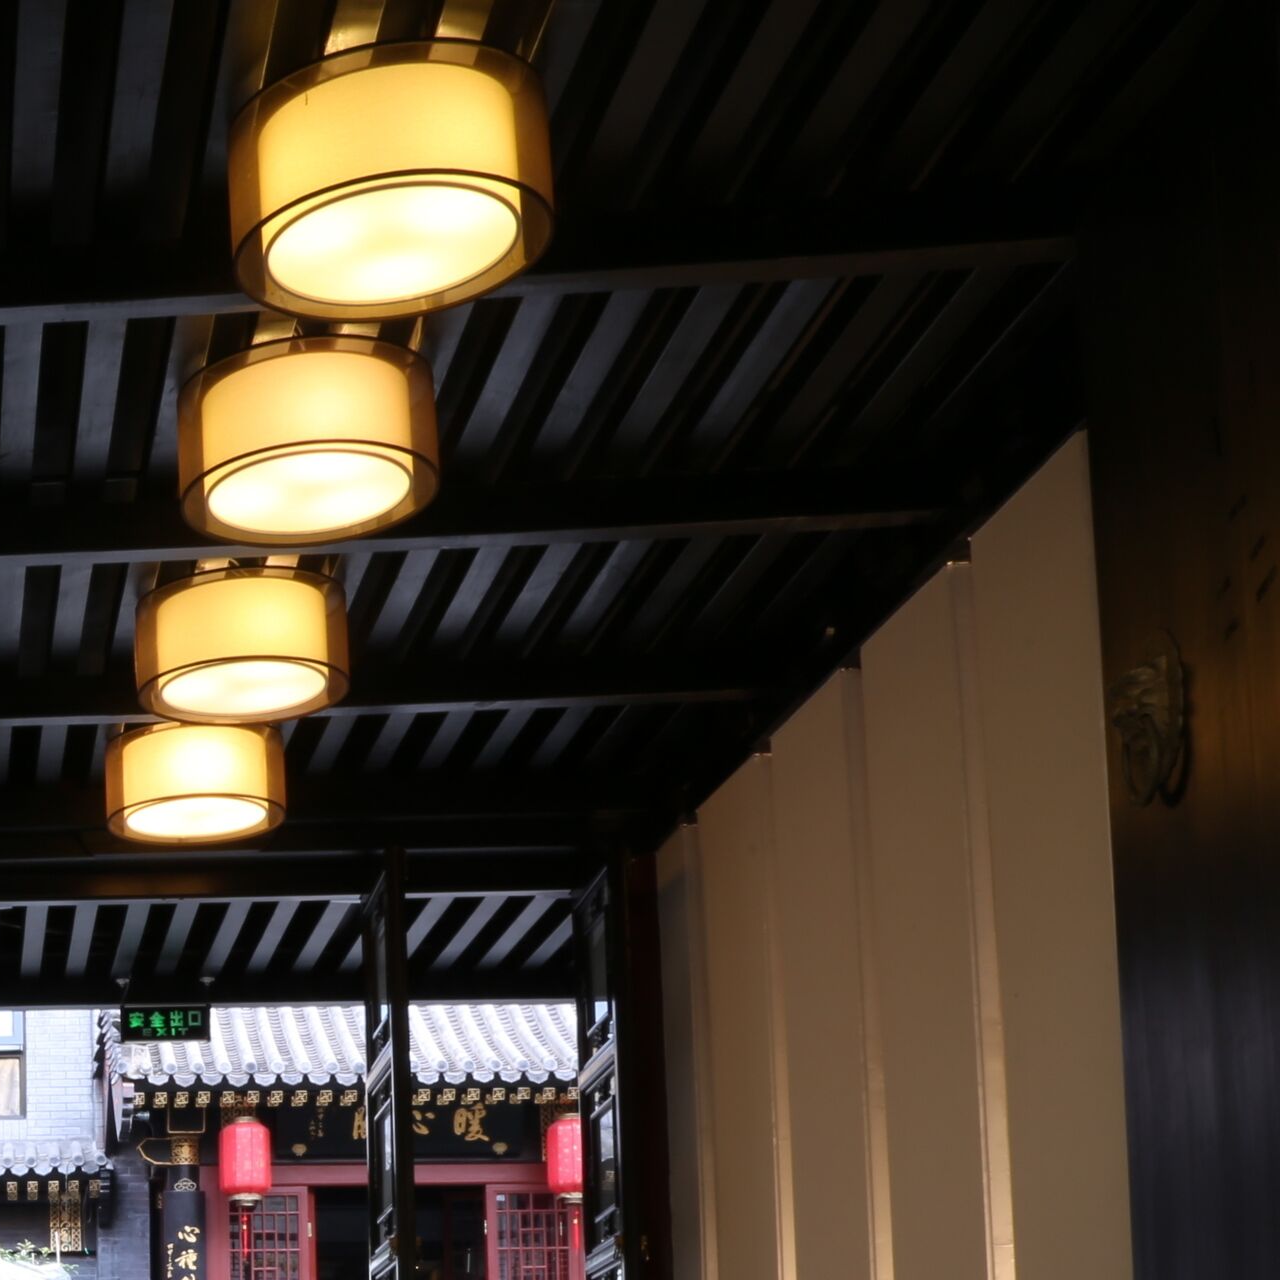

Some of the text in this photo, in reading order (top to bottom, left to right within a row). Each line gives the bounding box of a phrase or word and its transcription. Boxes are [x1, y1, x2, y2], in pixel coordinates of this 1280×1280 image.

[128, 1010, 202, 1028] 安全出口
[142, 1028, 189, 1037] EXIT
